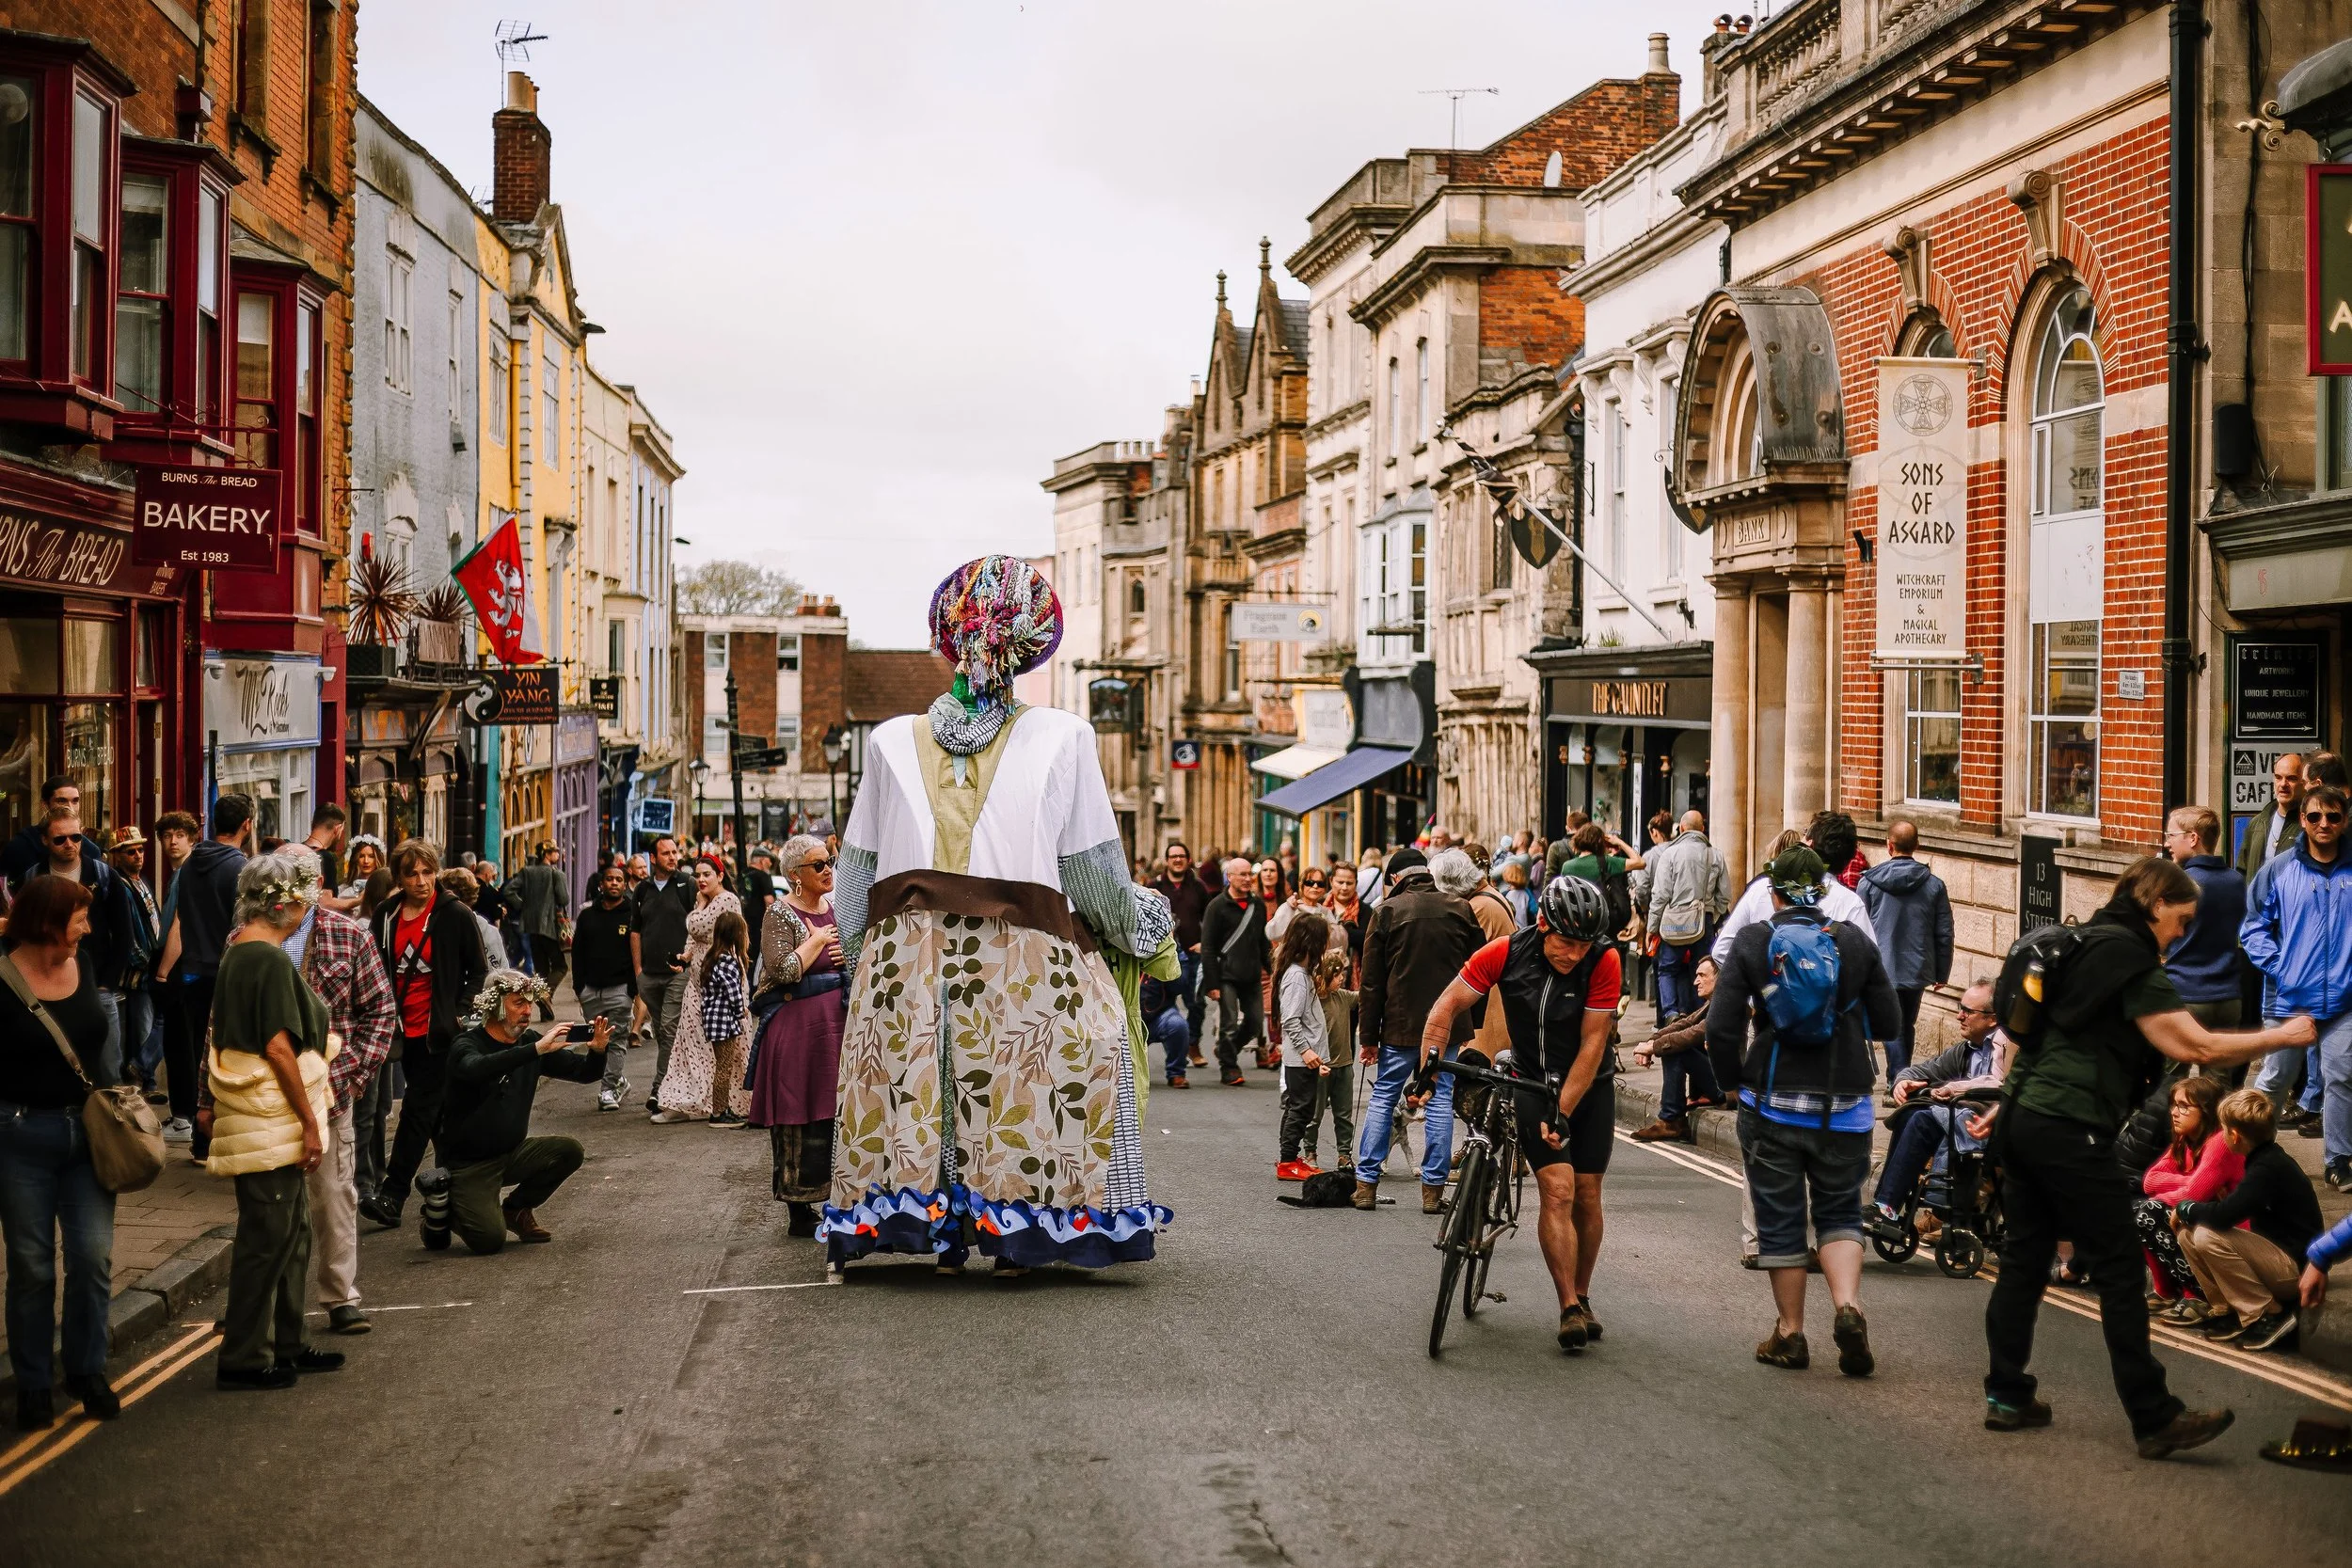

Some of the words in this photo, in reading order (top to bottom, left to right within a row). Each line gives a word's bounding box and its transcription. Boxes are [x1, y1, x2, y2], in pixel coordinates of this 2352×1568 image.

[162, 472, 198, 484] BURNS
[200, 475, 218, 485] The
[221, 476, 258, 487] BREAD
[1900, 463, 1944, 486] SONS
[1911, 492, 1933, 515] OF
[143, 501, 271, 534] BAKERY
[1739, 517, 1764, 543] BANK
[1888, 521, 1956, 544] ASGARD
[25, 529, 66, 579] The
[58, 531, 124, 586] BREAD
[181, 549, 198, 561] Est
[201, 551, 230, 562] 1983
[1896, 574, 1946, 586] WITCHCRAFT
[1899, 588, 1943, 599] EMPORIUM
[1917, 604, 1925, 615] &
[1903, 619, 1938, 630] MAGICAL
[1895, 633, 1947, 644] APOTHECARY
[516, 672, 541, 686] YIN
[505, 689, 550, 705] YANG
[1592, 682, 1610, 714] THE
[1612, 682, 1666, 716] GAUNTLET
[2247, 711, 2284, 720] HANDMADE
[2286, 711, 2307, 720] ITEMS
[2036, 863, 2046, 881] 13
[2028, 886, 2052, 908] HIGH
